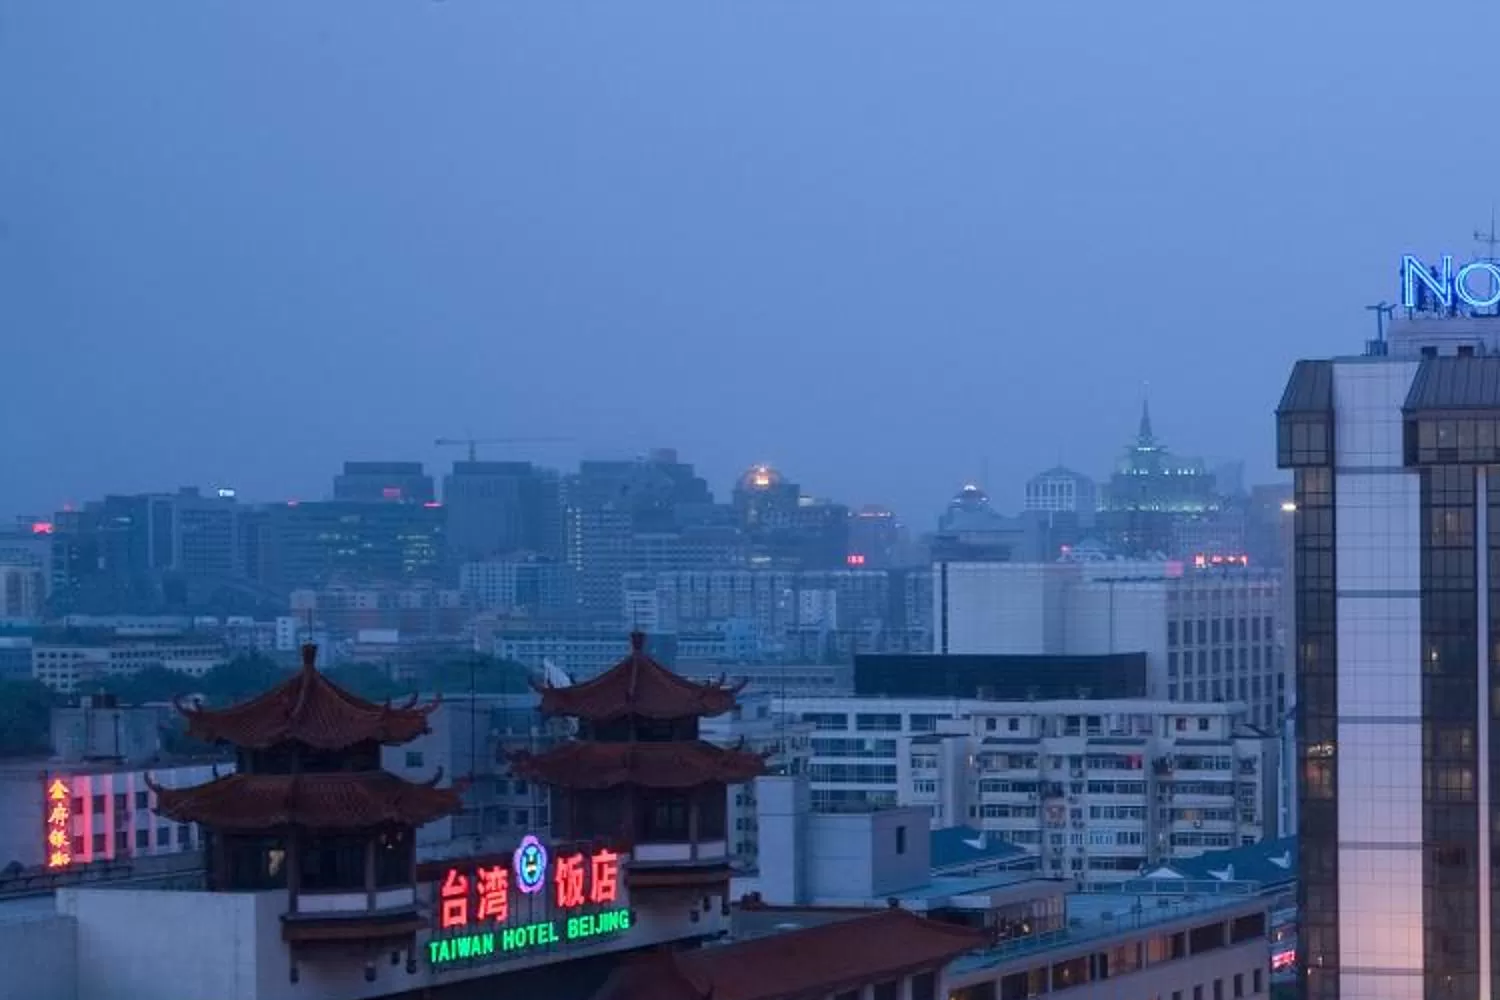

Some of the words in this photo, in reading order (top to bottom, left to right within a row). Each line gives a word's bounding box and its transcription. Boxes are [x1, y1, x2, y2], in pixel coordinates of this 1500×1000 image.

[429, 933, 494, 963] TAIWAN
[502, 922, 559, 951] HOTEL
[567, 909, 630, 940] BEIJING
